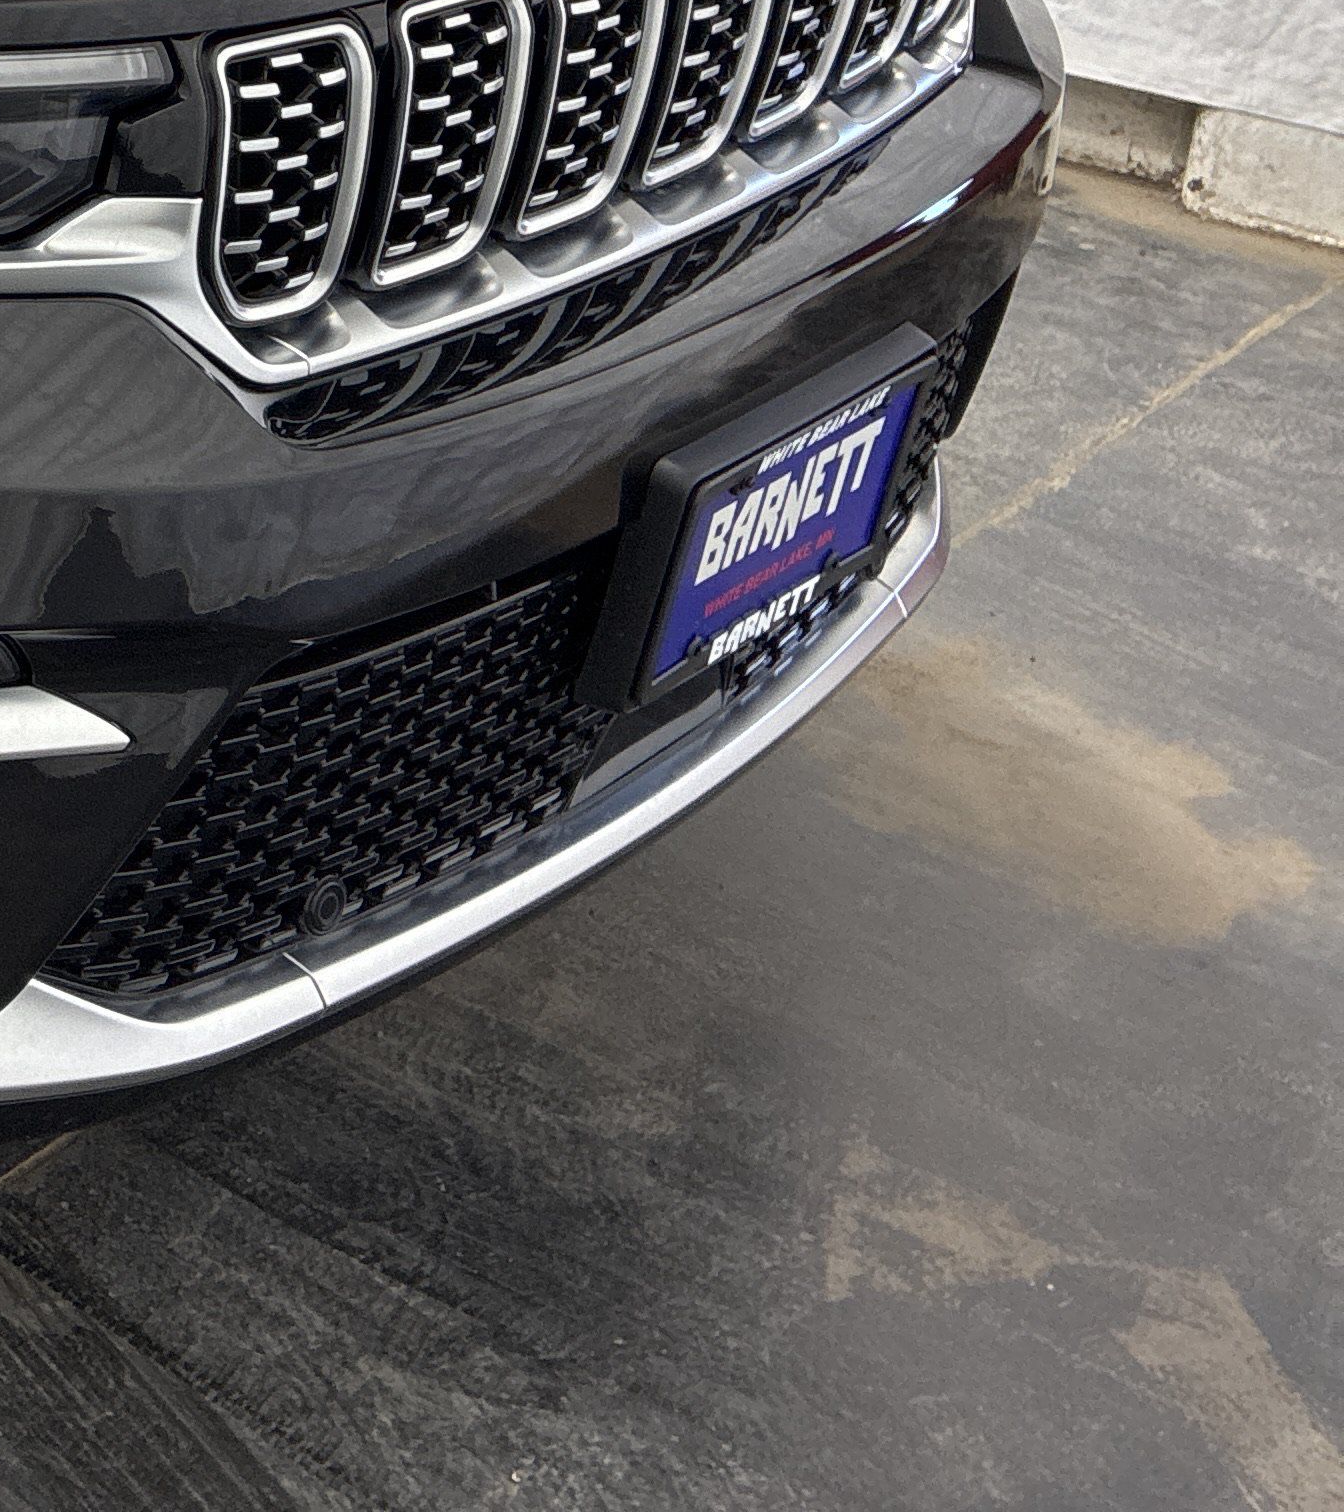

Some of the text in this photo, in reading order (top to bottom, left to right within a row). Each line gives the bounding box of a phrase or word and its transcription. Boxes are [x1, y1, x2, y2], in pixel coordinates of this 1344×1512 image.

[757, 385, 891, 476] WHITE BEAR LAKE
[694, 416, 886, 586] BARNETT
[704, 582, 743, 618] WHITE
[744, 561, 779, 593] BEAR
[708, 574, 821, 666] BARNETT
